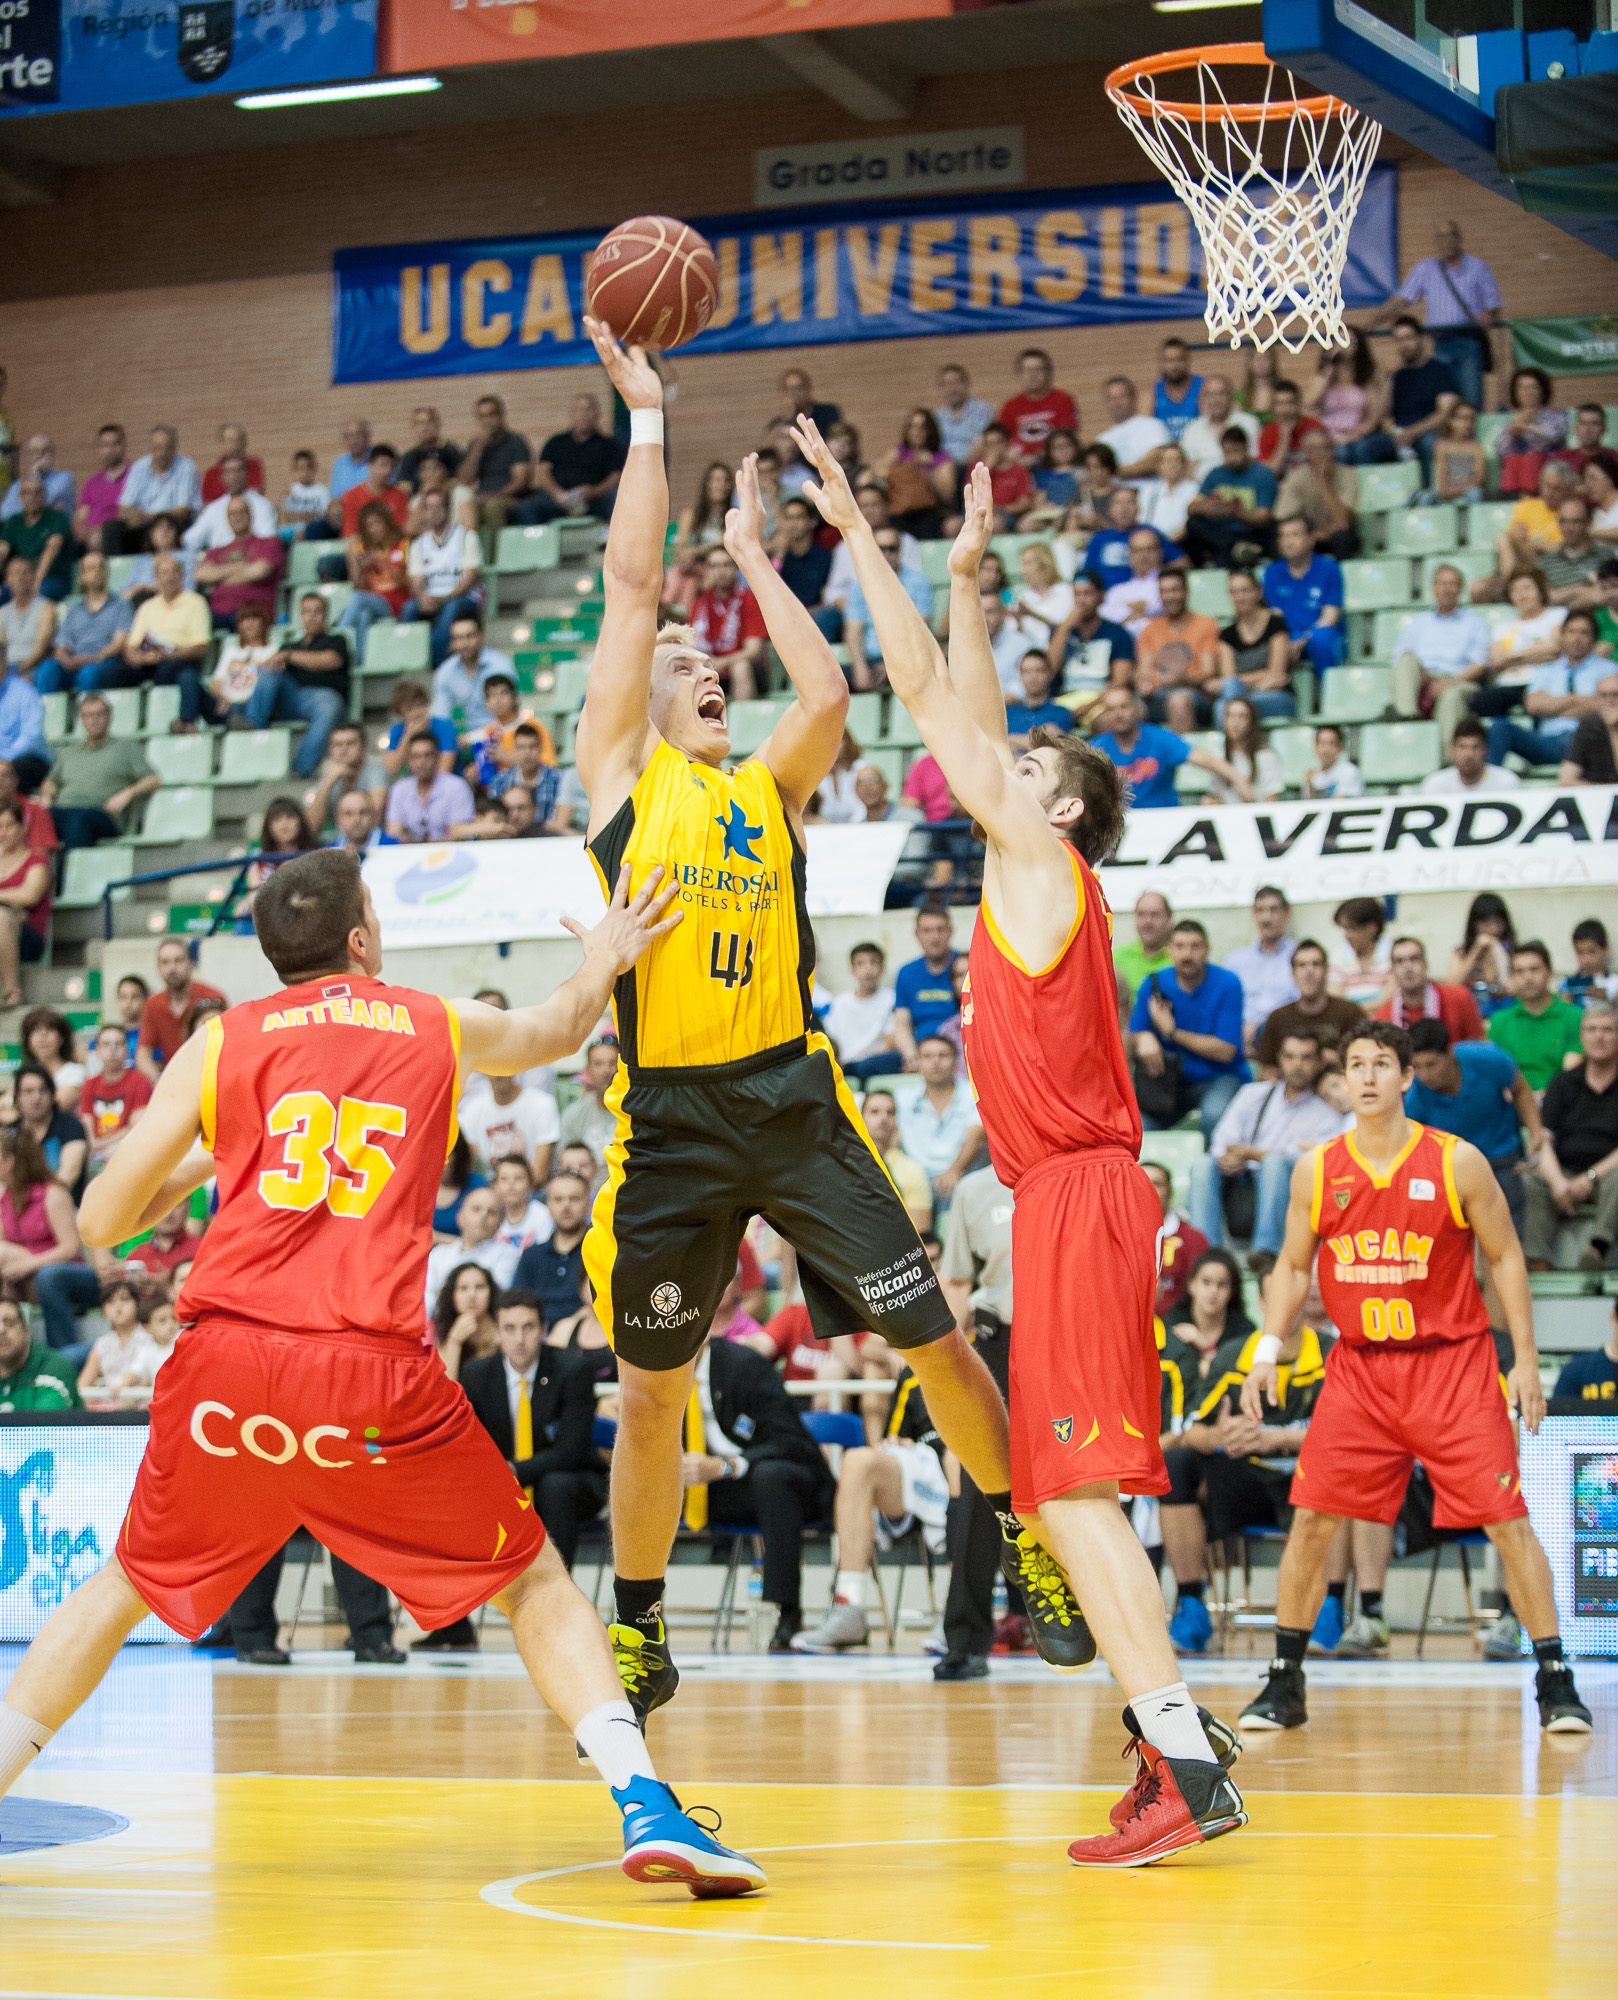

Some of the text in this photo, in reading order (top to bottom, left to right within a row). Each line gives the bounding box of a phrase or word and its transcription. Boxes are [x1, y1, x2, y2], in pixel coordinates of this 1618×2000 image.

[83, 8, 168, 39] Región
[768, 144, 1012, 190] Grada Norte
[1255, 796, 1618, 858] VERDA
[262, 997, 416, 1035] ARTEAGA
[257, 1090, 407, 1219] 35
[1328, 1228, 1434, 1264] UCAM
[854, 1247, 923, 1285] Teleférico del Teide
[859, 1265, 922, 1301] Volcano
[625, 1306, 700, 1329] LA LAGUNA
[868, 1301, 885, 1317] life
[1360, 1297, 1416, 1341] 00
